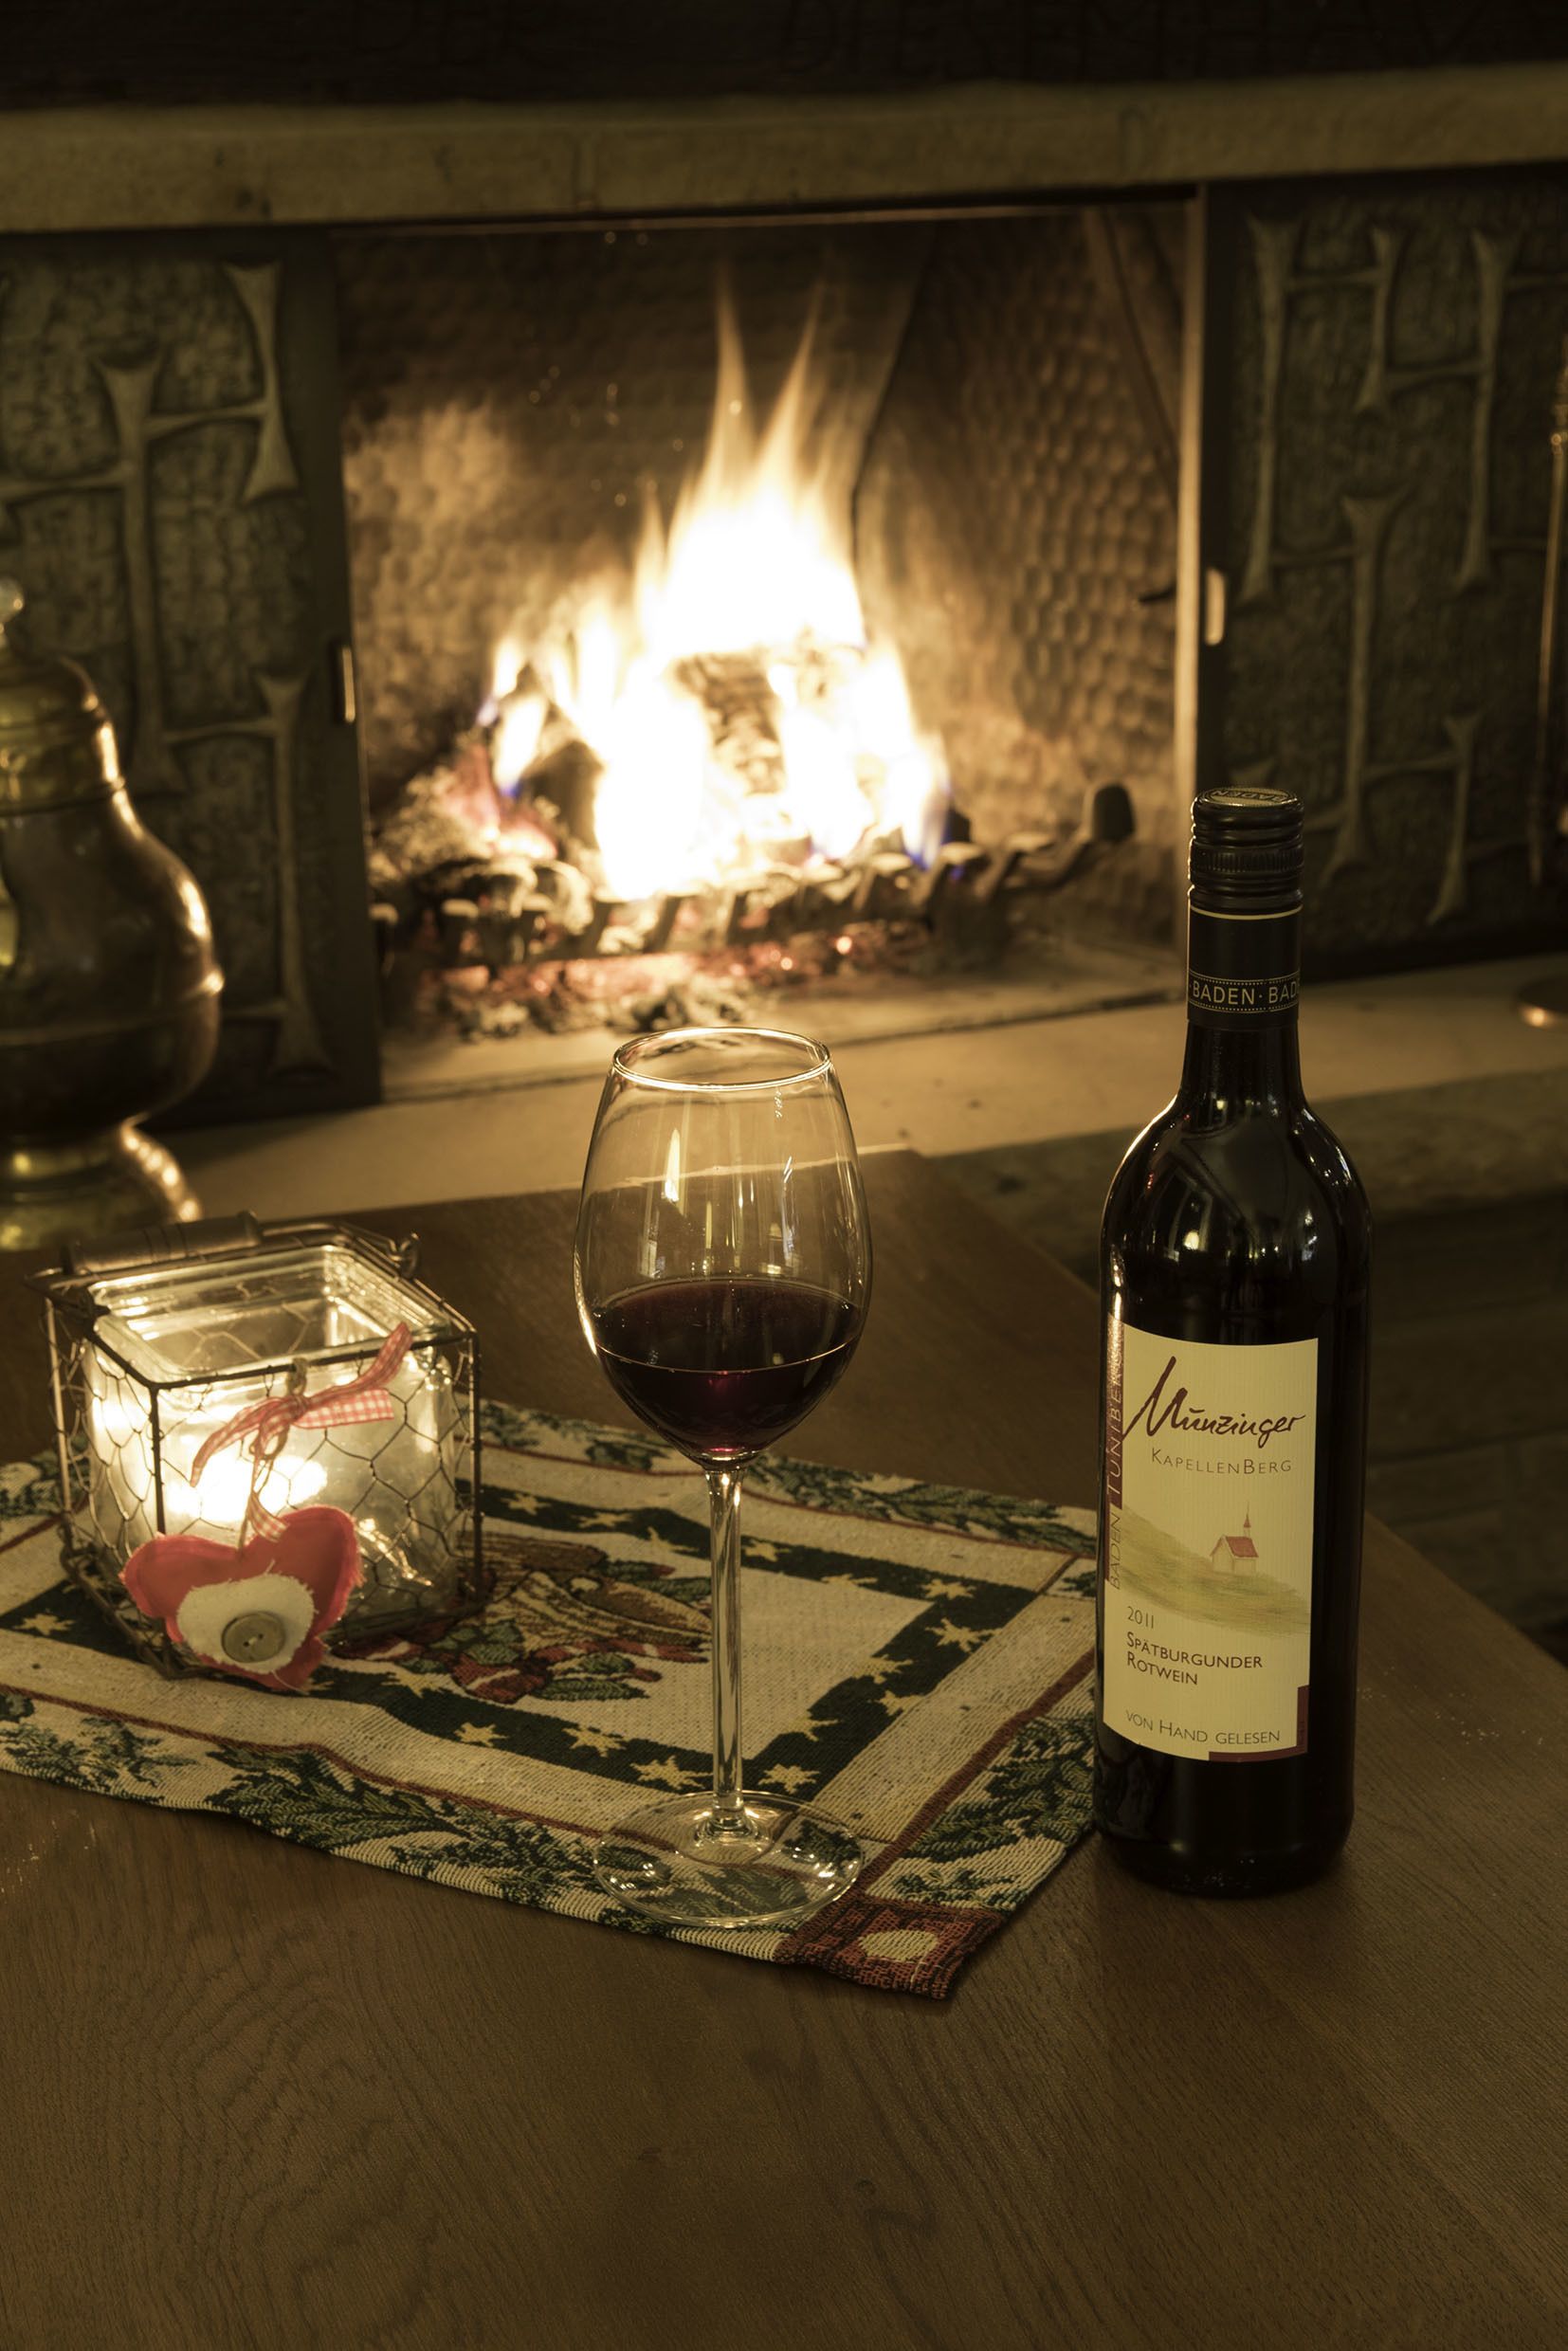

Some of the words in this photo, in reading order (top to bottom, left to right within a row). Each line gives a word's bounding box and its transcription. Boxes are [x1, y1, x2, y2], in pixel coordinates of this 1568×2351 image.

[1212, 790, 1285, 802] BADEN
[1193, 980, 1254, 1005] BADEN
[1268, 981, 1300, 1004] BAD
[1108, 1513, 1122, 1590] BADEN
[1126, 1606, 1155, 1630] 2011
[1126, 1650, 1198, 1686] ROTWEIN
[1125, 1708, 1154, 1732] VON
[1159, 1720, 1209, 1743] HAND
[1215, 1730, 1281, 1746] GELESEN
